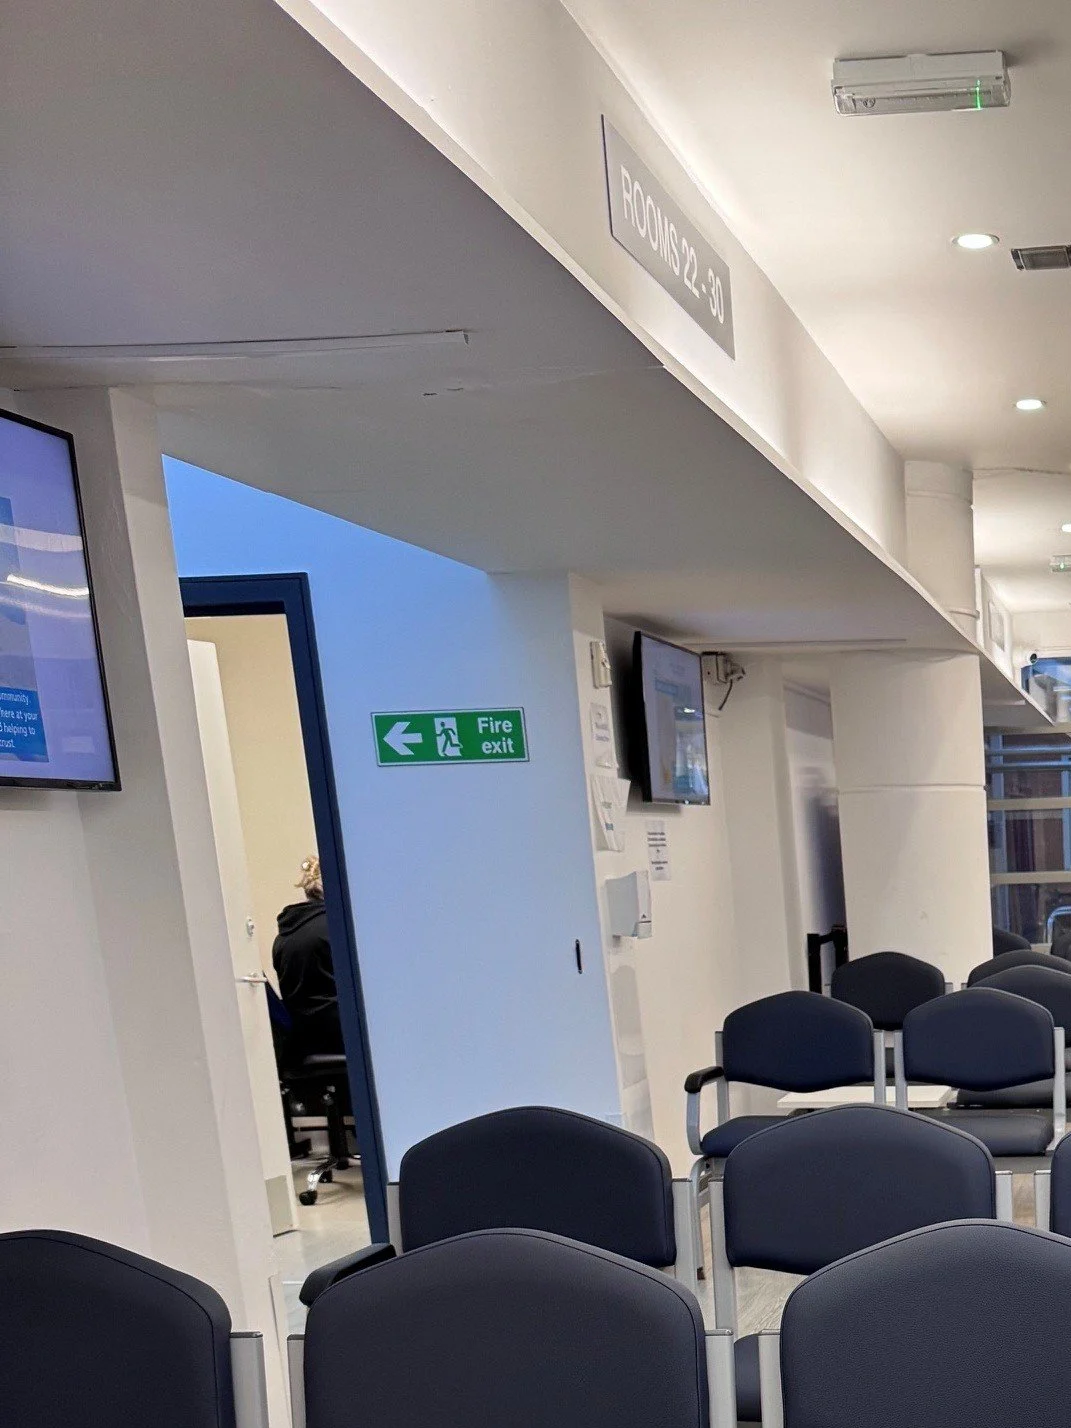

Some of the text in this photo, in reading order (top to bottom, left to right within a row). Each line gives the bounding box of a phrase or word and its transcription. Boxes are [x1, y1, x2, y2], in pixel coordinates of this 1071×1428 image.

[620, 164, 680, 276] ROOMS
[681, 237, 700, 298] 22
[708, 268, 725, 325] 30
[4, 723, 27, 737] helping
[477, 716, 513, 734] Fire
[481, 737, 515, 754] exit
